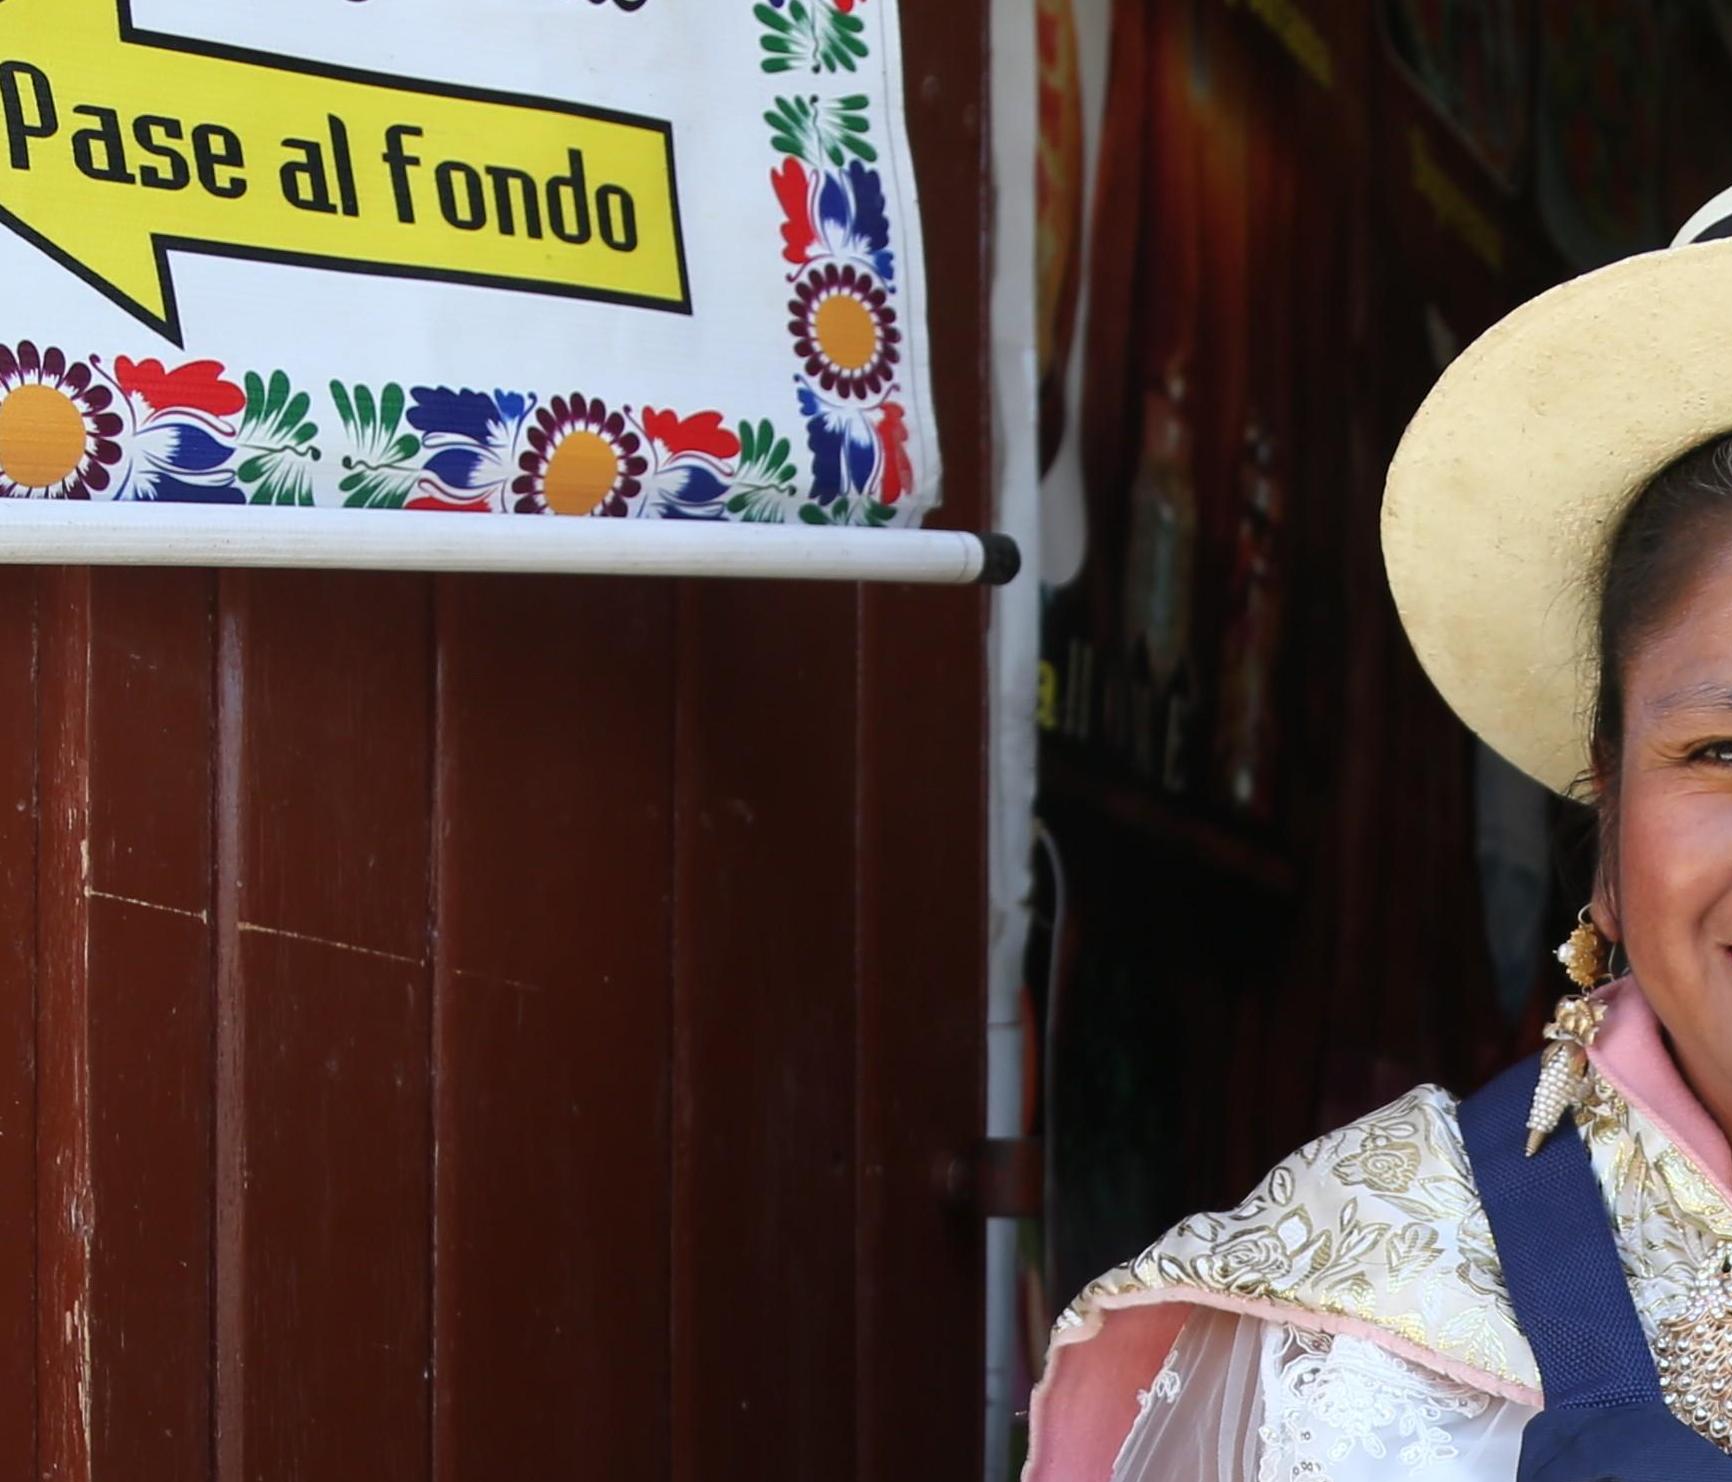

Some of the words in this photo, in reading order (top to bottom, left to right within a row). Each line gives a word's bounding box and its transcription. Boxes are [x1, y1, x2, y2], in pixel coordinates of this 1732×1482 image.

[0, 60, 248, 198] Pase
[280, 114, 359, 216] al
[383, 124, 639, 253] fondo
